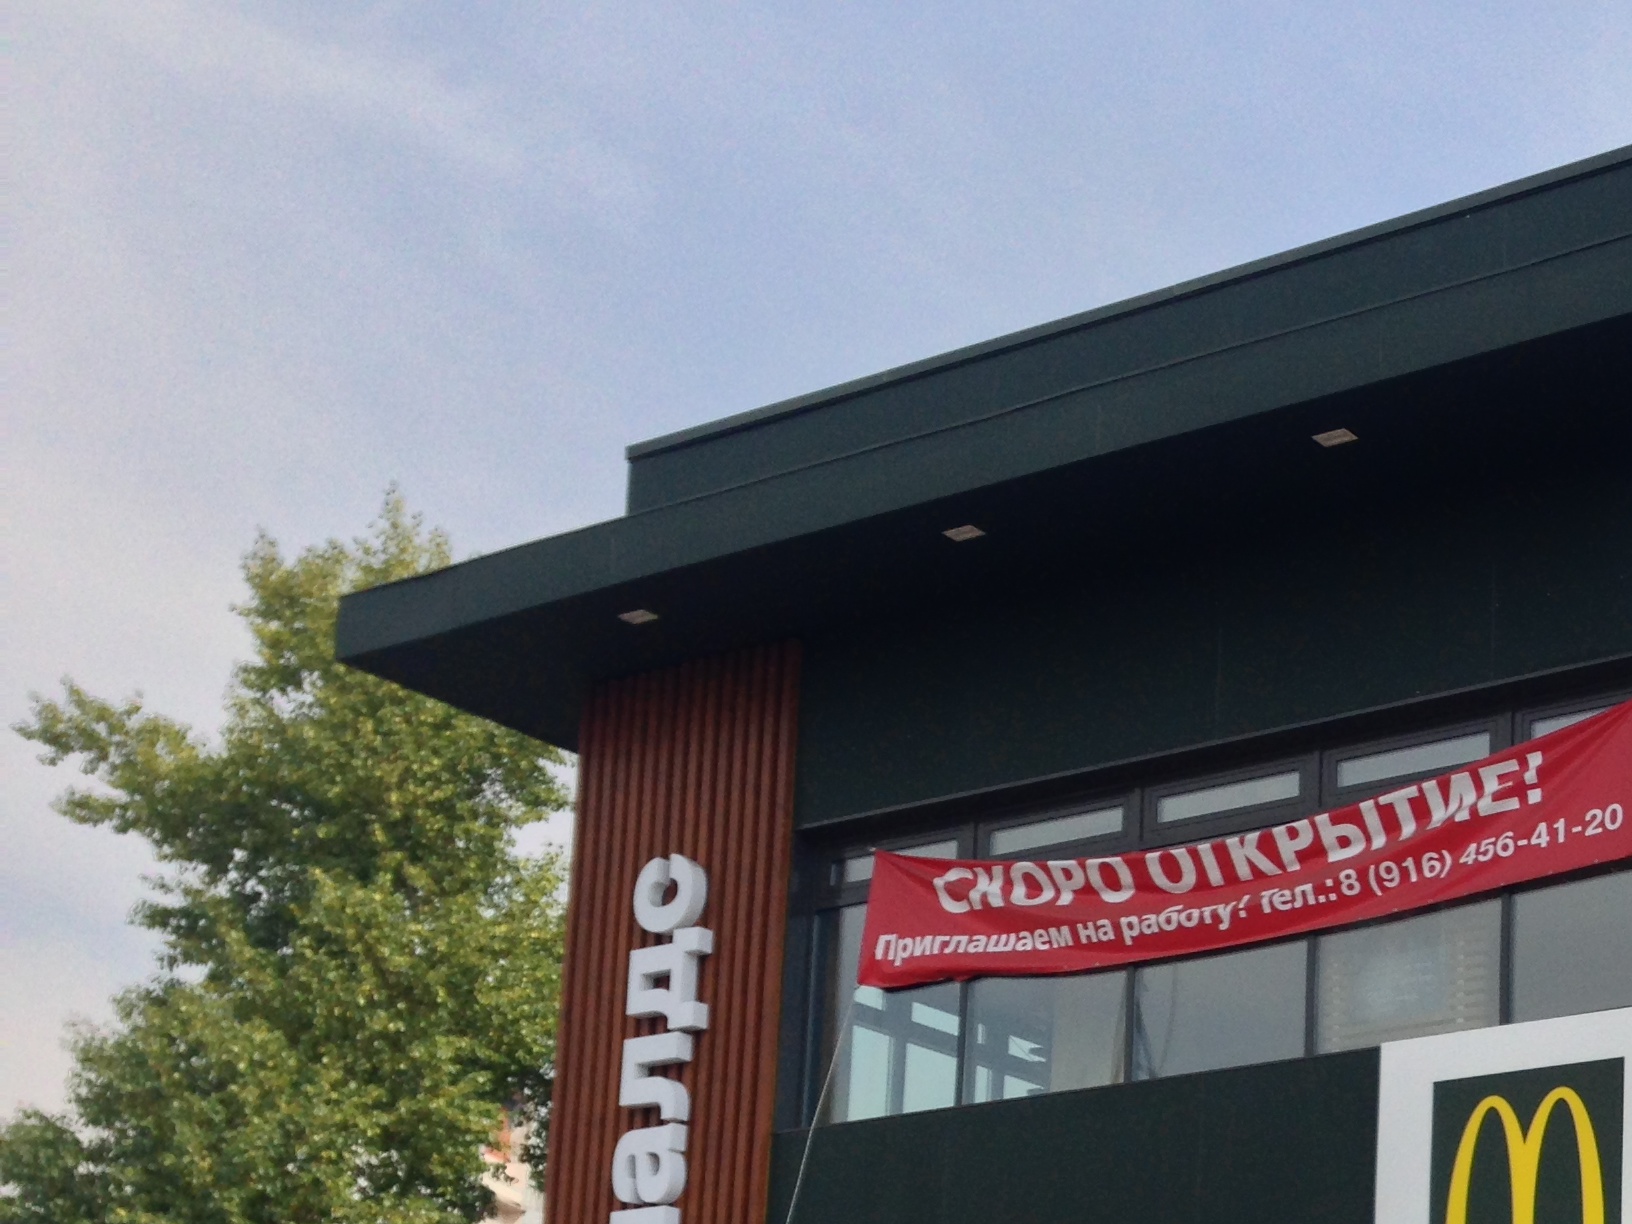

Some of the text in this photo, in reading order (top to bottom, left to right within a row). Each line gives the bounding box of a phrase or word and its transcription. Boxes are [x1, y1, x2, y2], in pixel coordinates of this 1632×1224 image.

[874, 923, 1073, 967] Приглашаем
[1078, 917, 1115, 945] на
[1119, 895, 1250, 945] работу!
[1338, 868, 1361, 896] 8
[1368, 850, 1452, 896] (916)
[1458, 803, 1624, 865] 456-41-20
[932, 751, 1544, 914] СКОРО ОТКРЫТИЕ!
